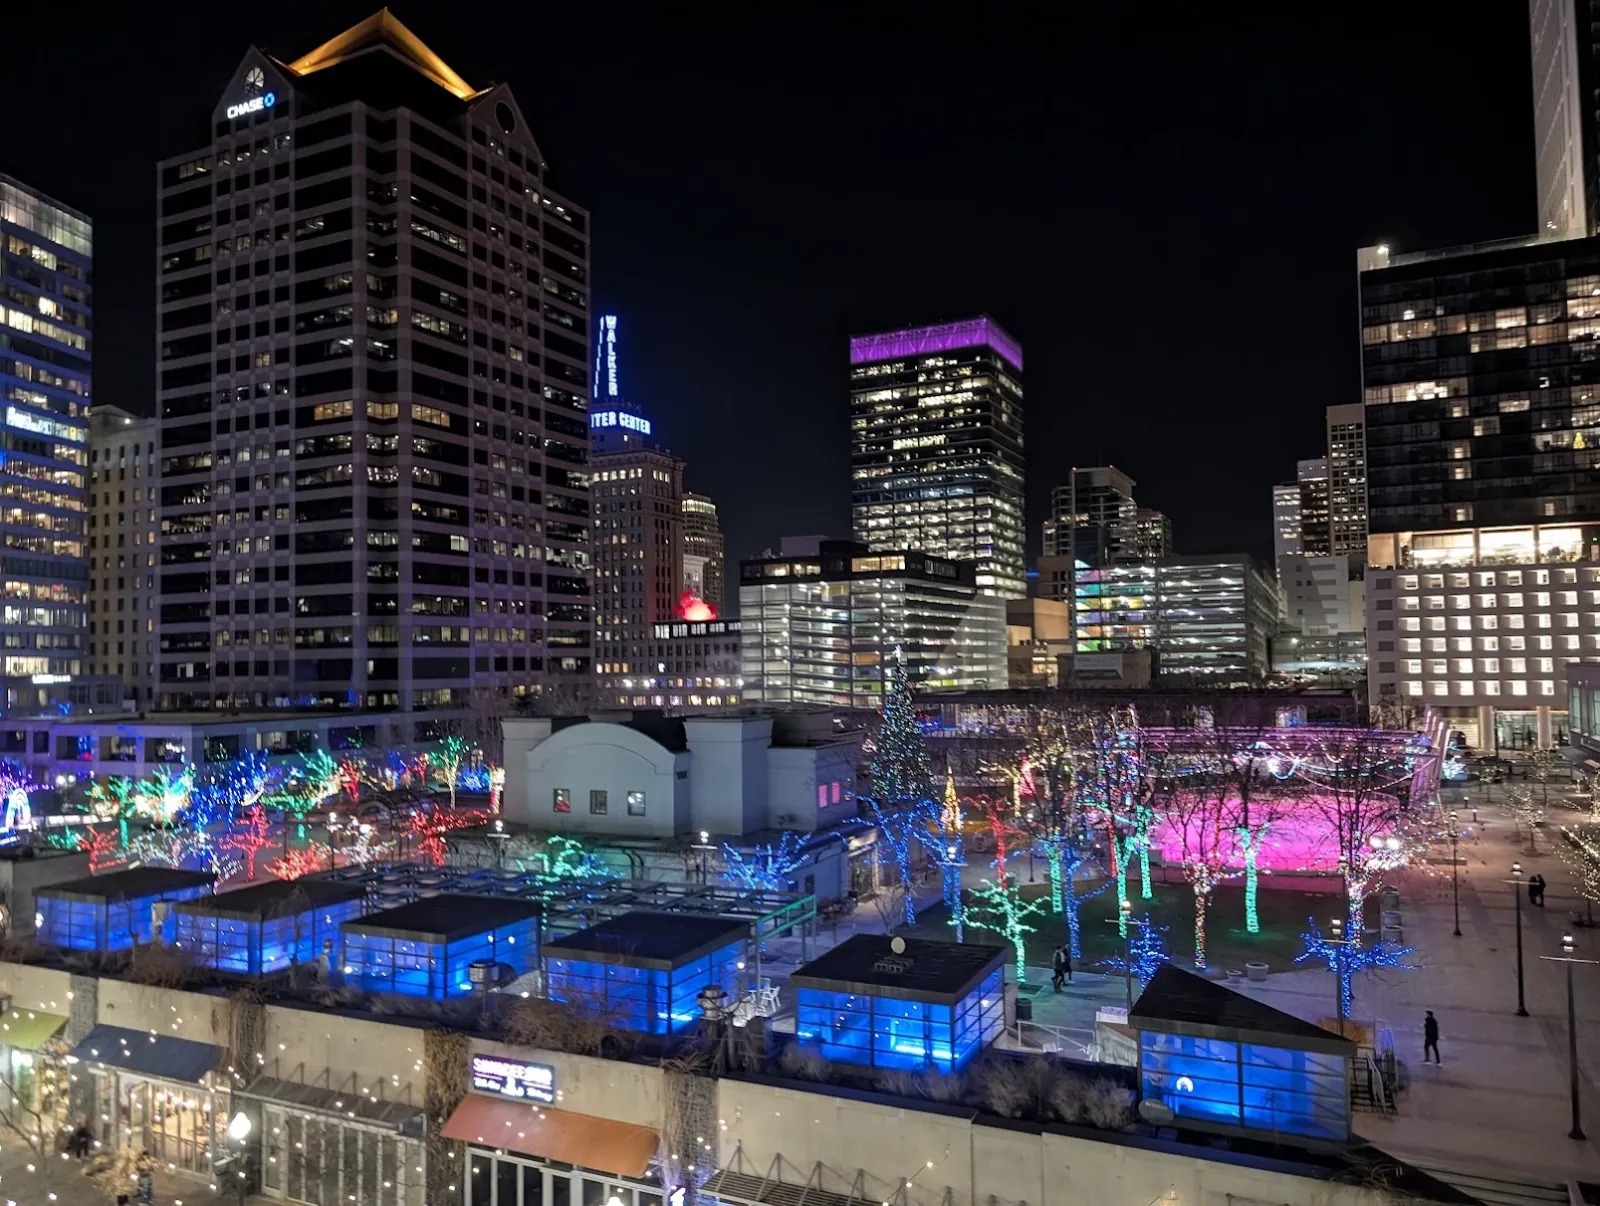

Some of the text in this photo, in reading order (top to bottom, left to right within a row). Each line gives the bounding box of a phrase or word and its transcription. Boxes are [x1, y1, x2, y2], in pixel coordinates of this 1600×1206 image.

[227, 96, 264, 119] CHASE
[605, 315, 618, 396] WALKER
[619, 411, 651, 434] CENTER
